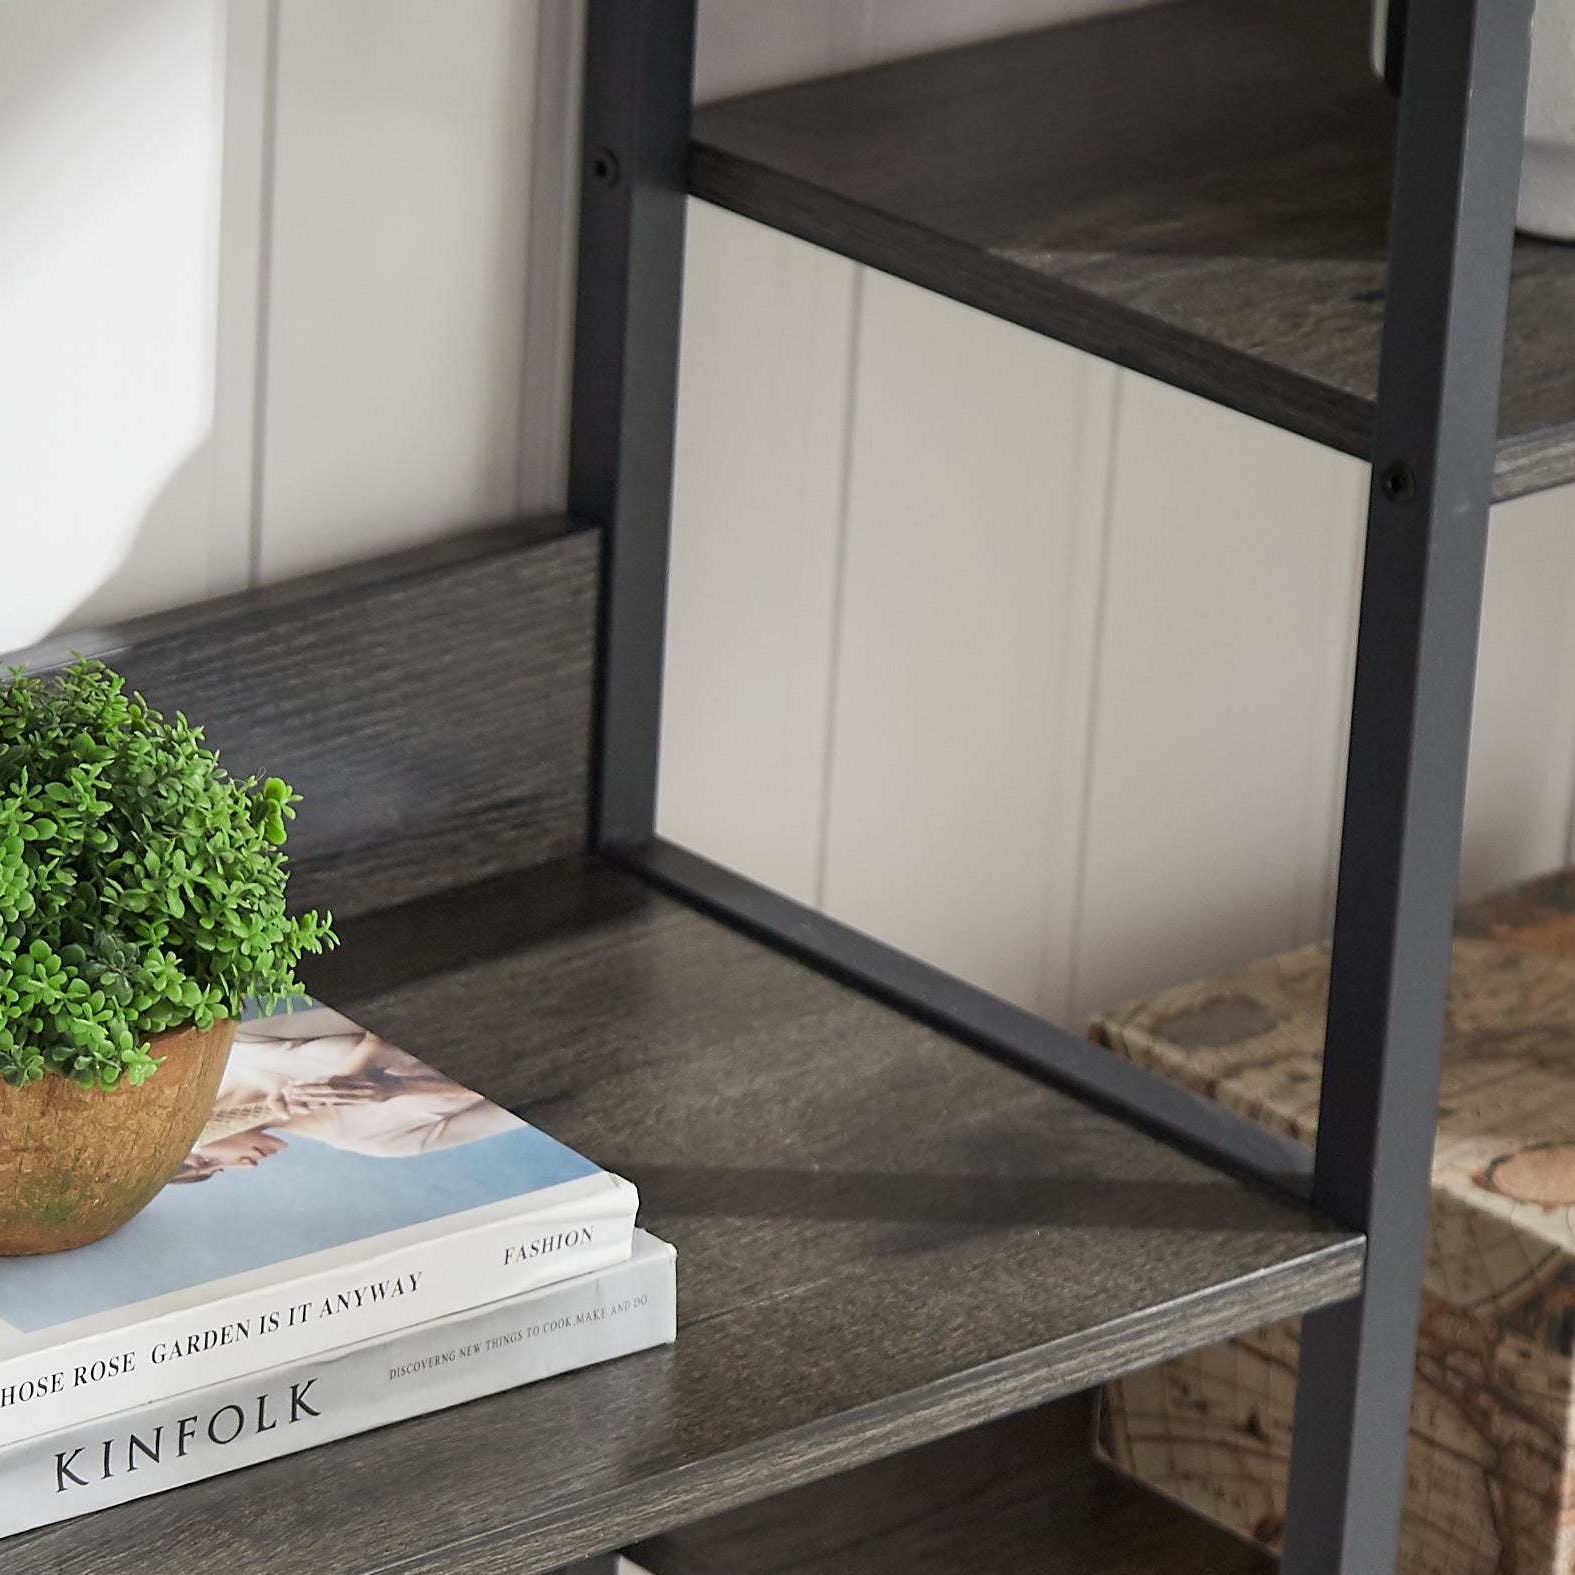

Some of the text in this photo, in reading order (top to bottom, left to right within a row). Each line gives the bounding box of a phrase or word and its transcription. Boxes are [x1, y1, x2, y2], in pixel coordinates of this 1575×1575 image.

[504, 1226, 595, 1265] FASHION
[73, 1352, 136, 1386] ROSE
[151, 1319, 250, 1365] GARDEN
[260, 1311, 279, 1335] IS
[289, 1303, 312, 1328] IT
[319, 1272, 423, 1319] ANYWAY
[389, 1351, 456, 1380] DISCOVERNG
[459, 1343, 482, 1358] NEW
[485, 1331, 523, 1351] THINGS
[527, 1326, 540, 1338] TO
[611, 1300, 630, 1316] AND
[633, 1294, 648, 1308] DO
[55, 1378, 322, 1493] KINFOLK
